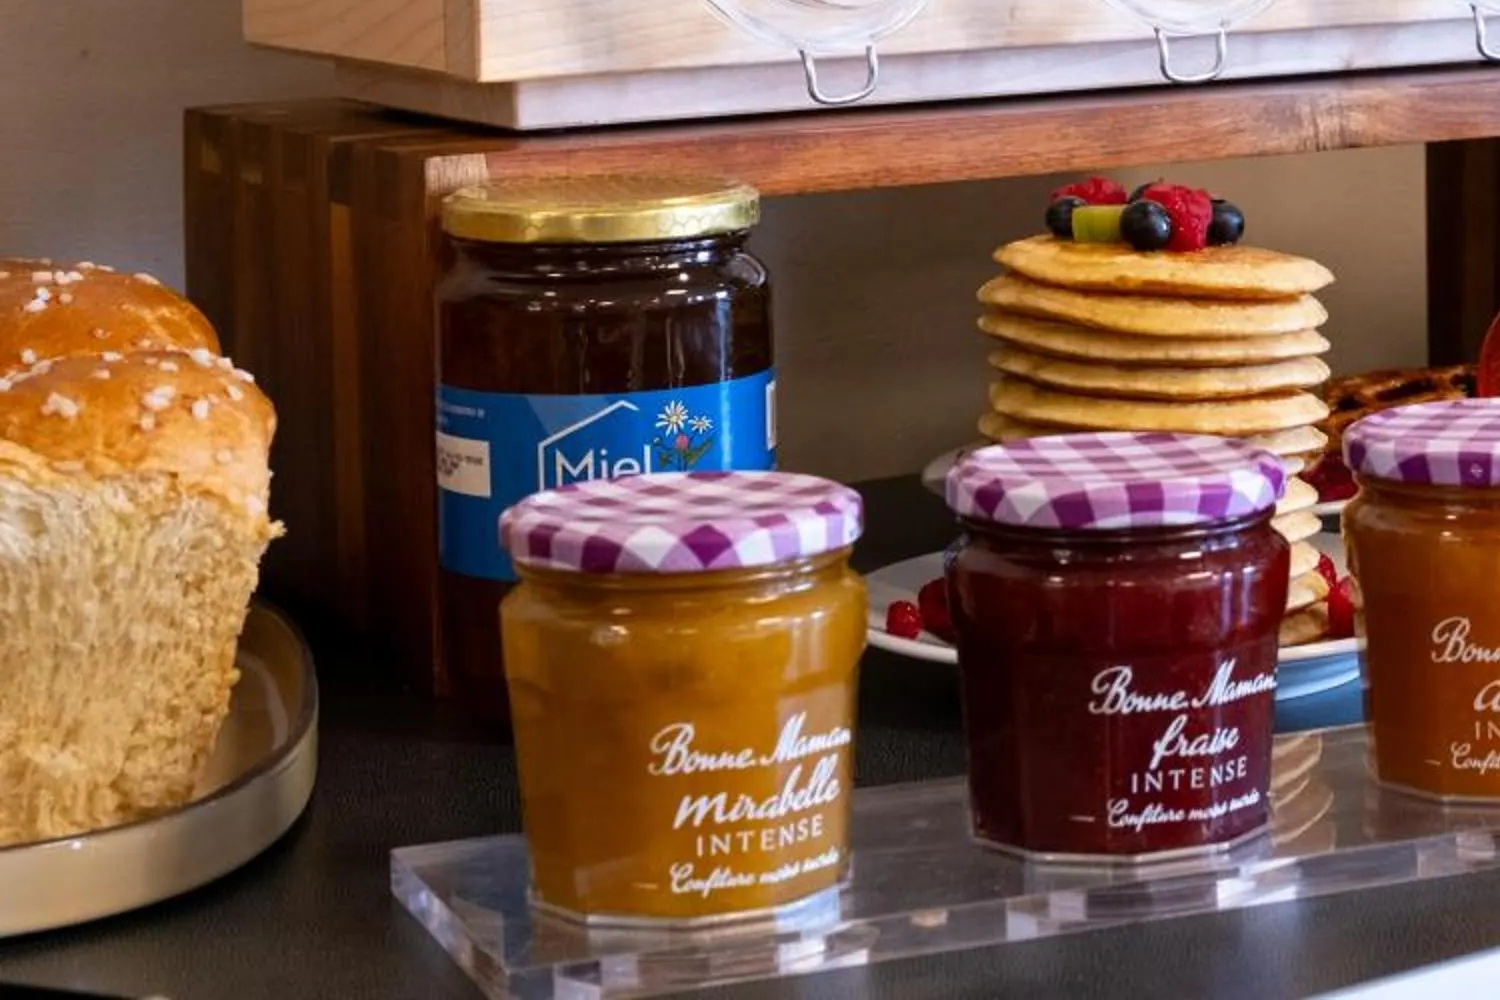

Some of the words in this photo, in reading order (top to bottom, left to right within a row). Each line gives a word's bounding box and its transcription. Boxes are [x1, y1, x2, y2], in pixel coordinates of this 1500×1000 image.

[555, 443, 652, 488] Miel
[1088, 665, 1189, 715] Bonne
[647, 722, 755, 775] Bonne
[1130, 756, 1248, 795] INTENSE
[695, 813, 824, 858] INTENSE
[1106, 797, 1186, 833] Confiture
[669, 861, 756, 899] Confiture
